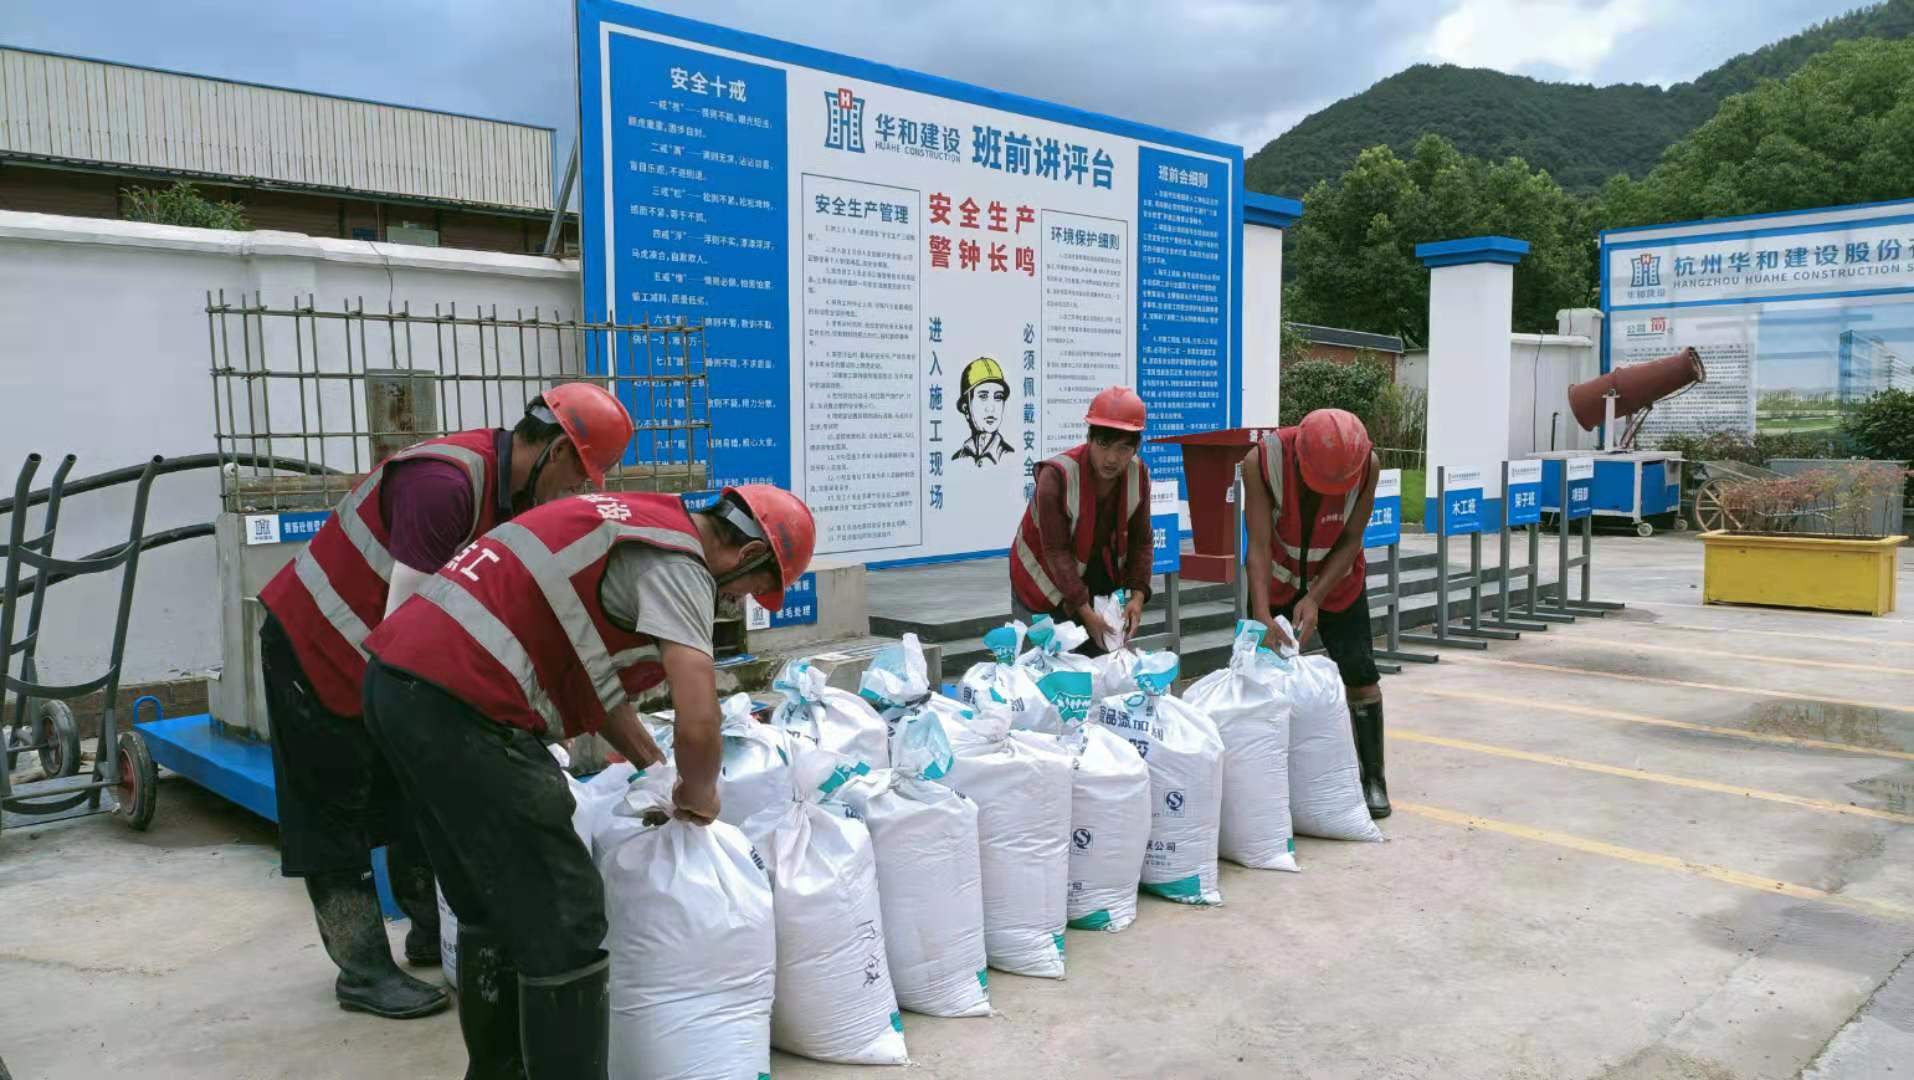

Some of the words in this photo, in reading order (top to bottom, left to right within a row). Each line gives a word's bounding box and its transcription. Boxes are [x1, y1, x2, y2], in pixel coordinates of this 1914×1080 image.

[670, 67, 746, 103] 安全十戒
[875, 112, 961, 154] 华和建设
[875, 140, 900, 153] HUAHE
[904, 146, 961, 164] CONSTRUCTION
[972, 125, 1114, 190] 班前讲评台
[815, 193, 909, 224] 安全生产管理
[929, 192, 1035, 234] 安全生产
[929, 235, 1035, 277] 警钟长鸣
[1051, 226, 1119, 250] 环境保护细则
[1673, 276, 1740, 288] HANGZHOU
[1746, 273, 1788, 285] HUAHE
[1793, 263, 1900, 281] CONSTRUCTION
[928, 317, 943, 509] 进入施工现场
[1452, 498, 1477, 516] 木工班
